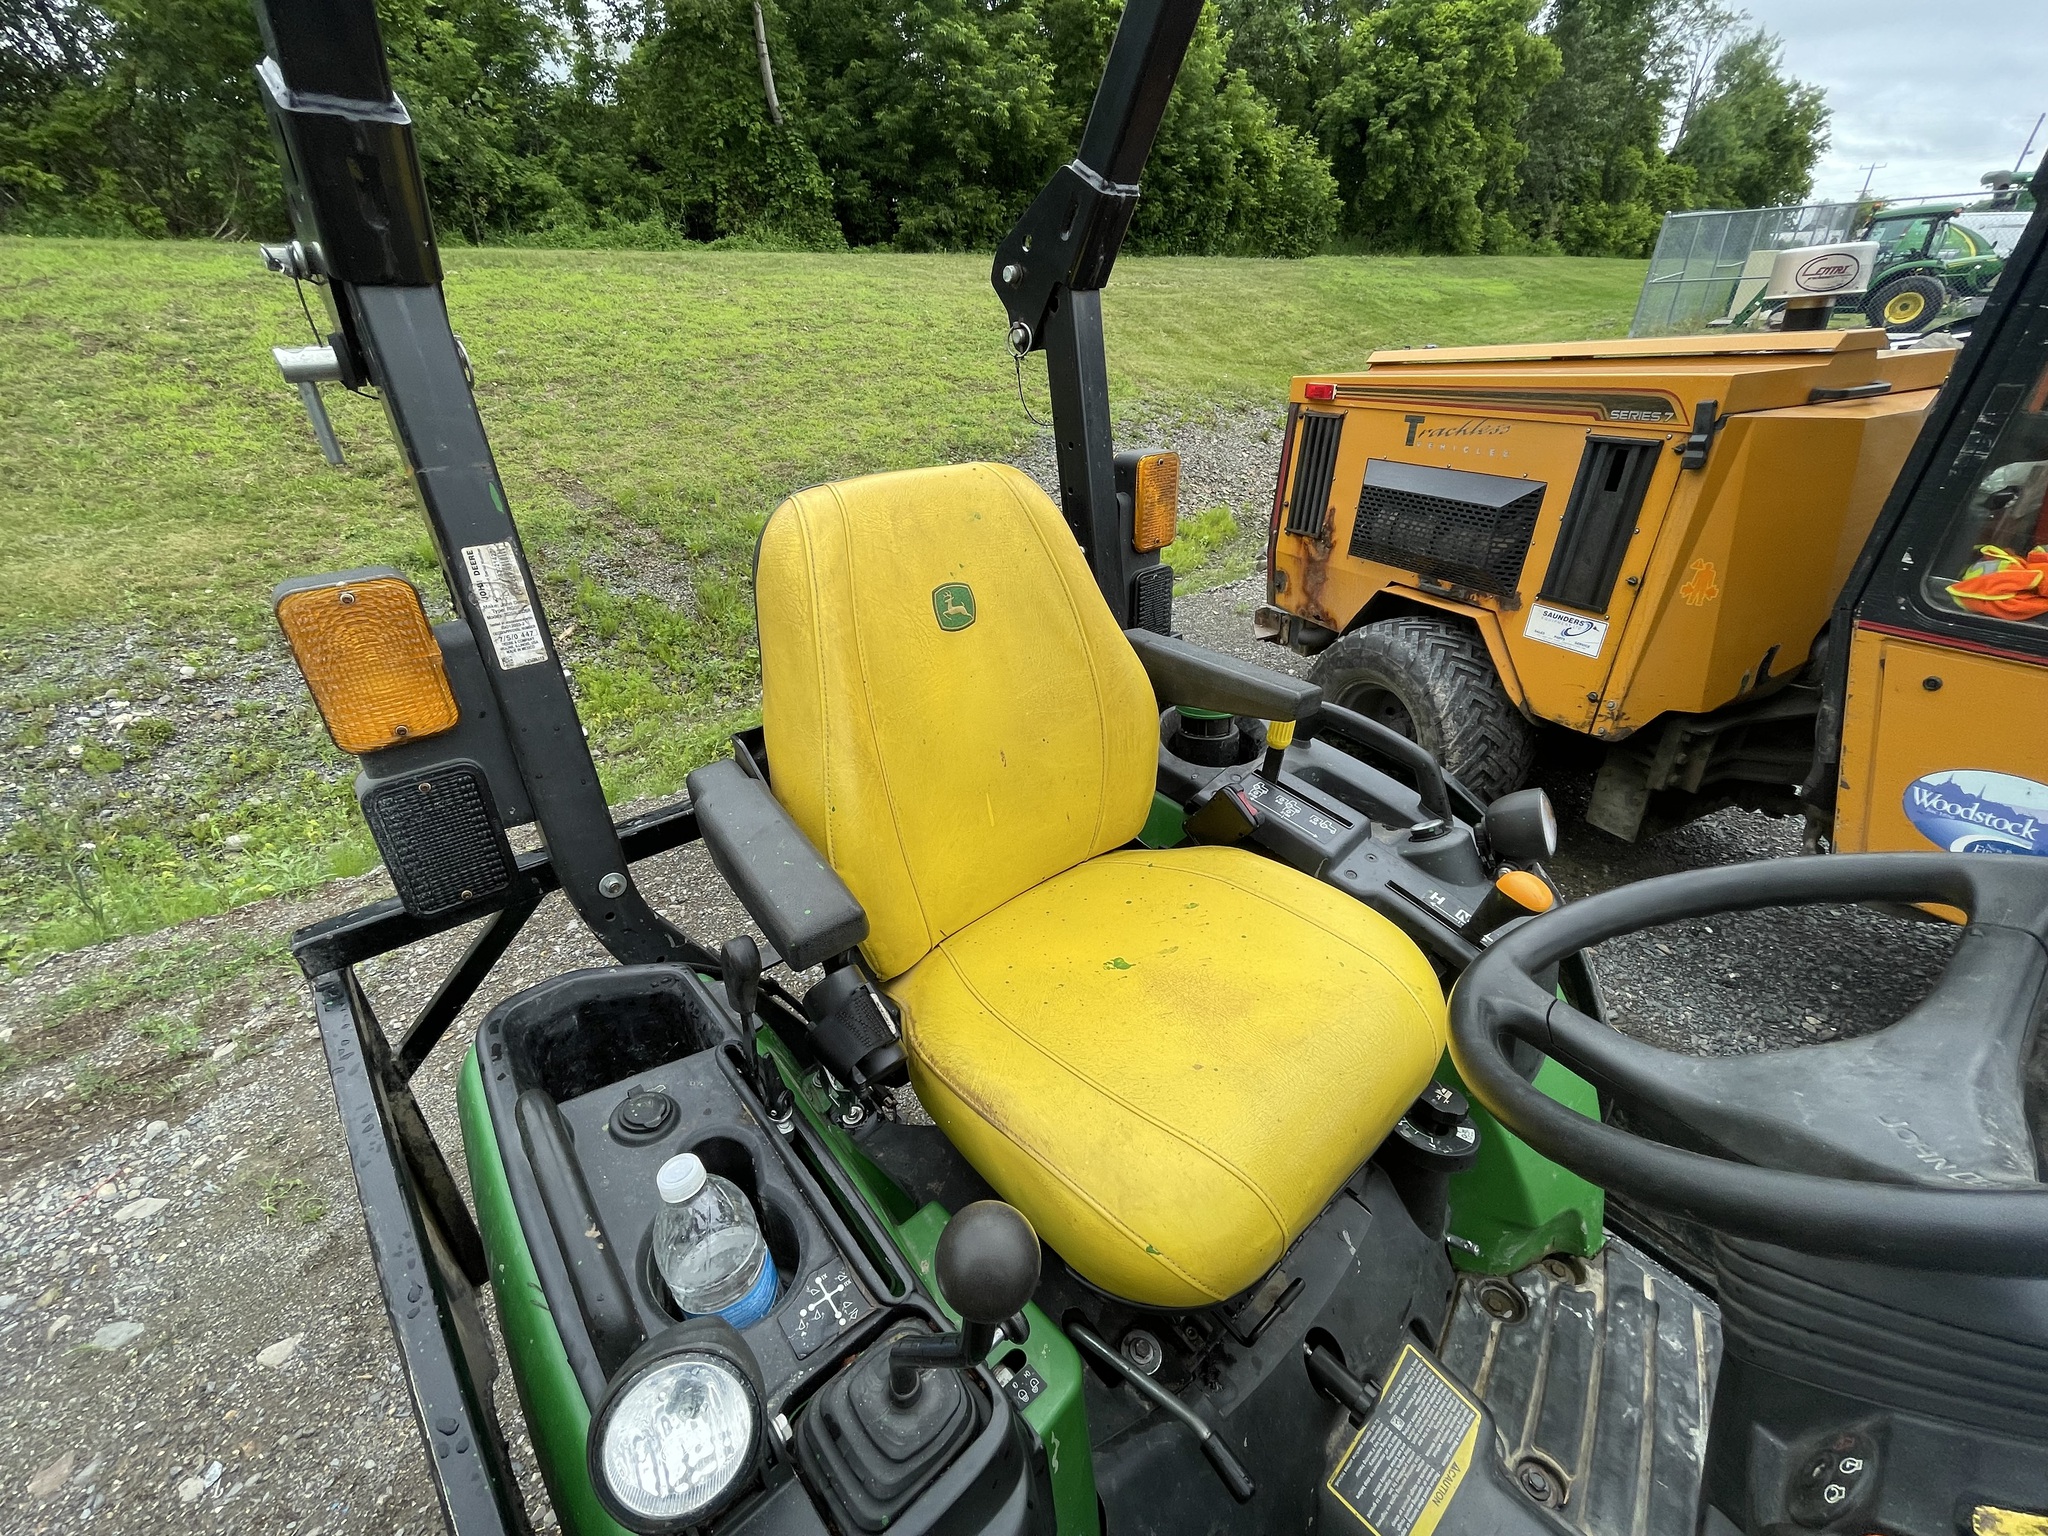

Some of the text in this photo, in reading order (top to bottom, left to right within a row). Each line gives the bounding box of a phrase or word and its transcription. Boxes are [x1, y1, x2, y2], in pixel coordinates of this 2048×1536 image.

[1610, 409, 1675, 423] SERIES 7
[1404, 415, 1511, 446] Trackless
[1416, 441, 1511, 458] VEHICLES
[467, 550, 480, 576] DEERE
[1542, 611, 1585, 627] SAUNDERS
[1913, 786, 2040, 841] Woodstock
[1429, 891, 1446, 905] H
[1874, 1115, 1957, 1171] JOHN
[1433, 1469, 1458, 1507] CAUTION
